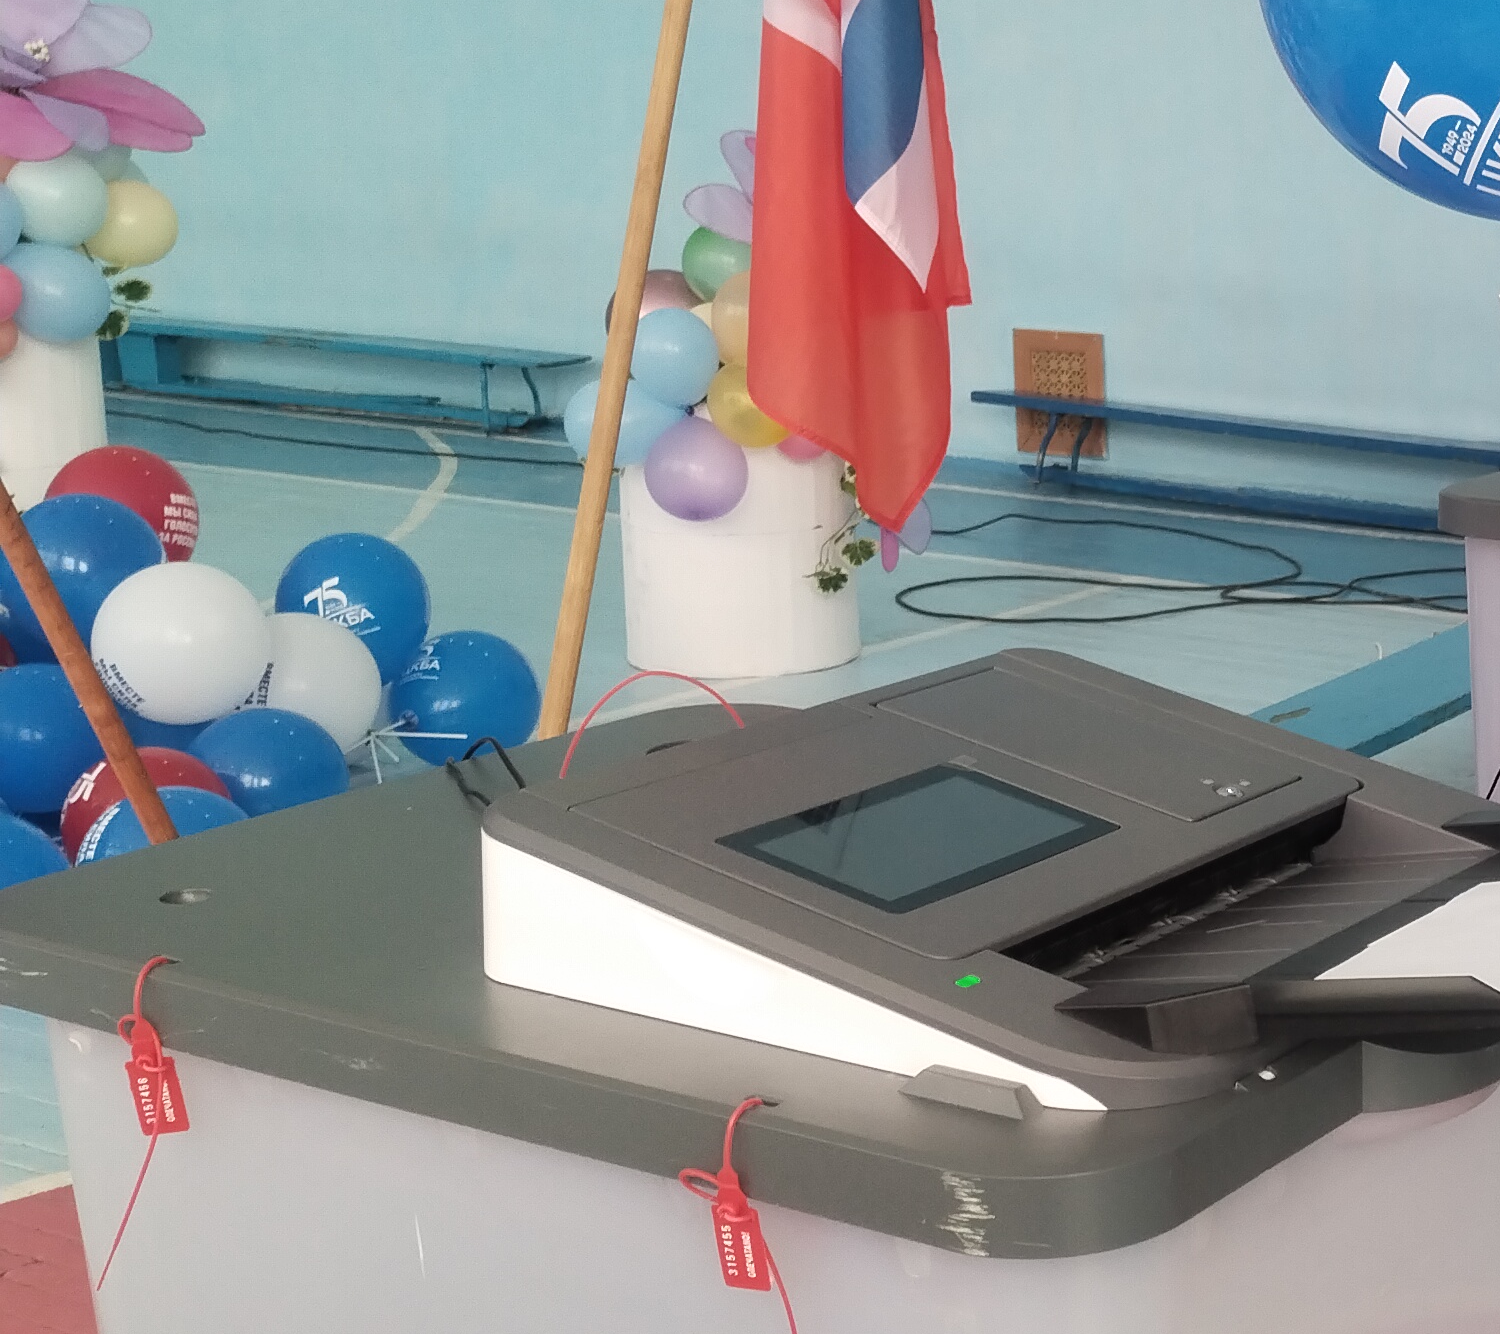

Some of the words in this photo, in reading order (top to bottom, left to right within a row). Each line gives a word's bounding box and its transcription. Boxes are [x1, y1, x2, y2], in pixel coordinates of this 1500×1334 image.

[303, 576, 347, 618] 75
[332, 608, 375, 628] КБА
[109, 663, 146, 703] ВМЕСТЕ
[721, 1225, 739, 1276] 3157455
